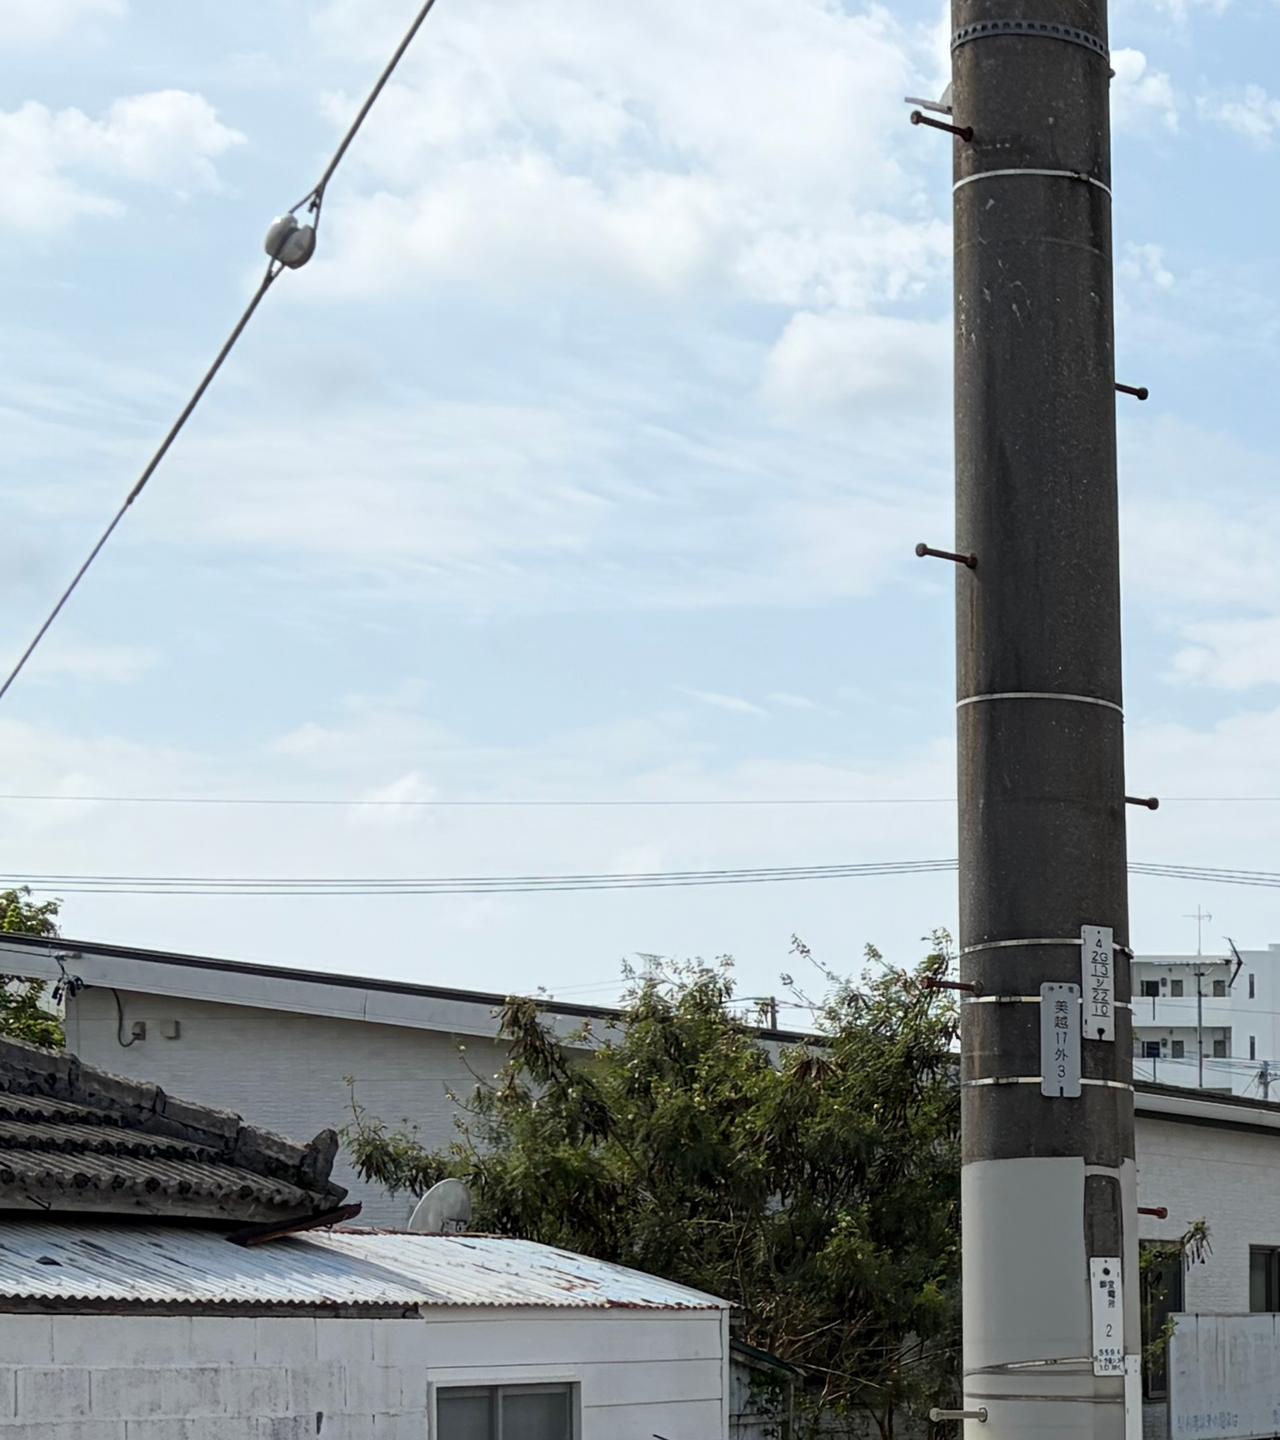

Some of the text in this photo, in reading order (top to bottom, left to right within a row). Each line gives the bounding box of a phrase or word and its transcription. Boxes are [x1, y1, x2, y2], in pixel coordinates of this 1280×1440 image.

[1091, 950, 1109, 963] 2G
[1093, 964, 1109, 976] 13
[1092, 990, 1109, 1002] 22
[1095, 1004, 1109, 1015] 10
[1105, 1323, 1113, 1338] 2
